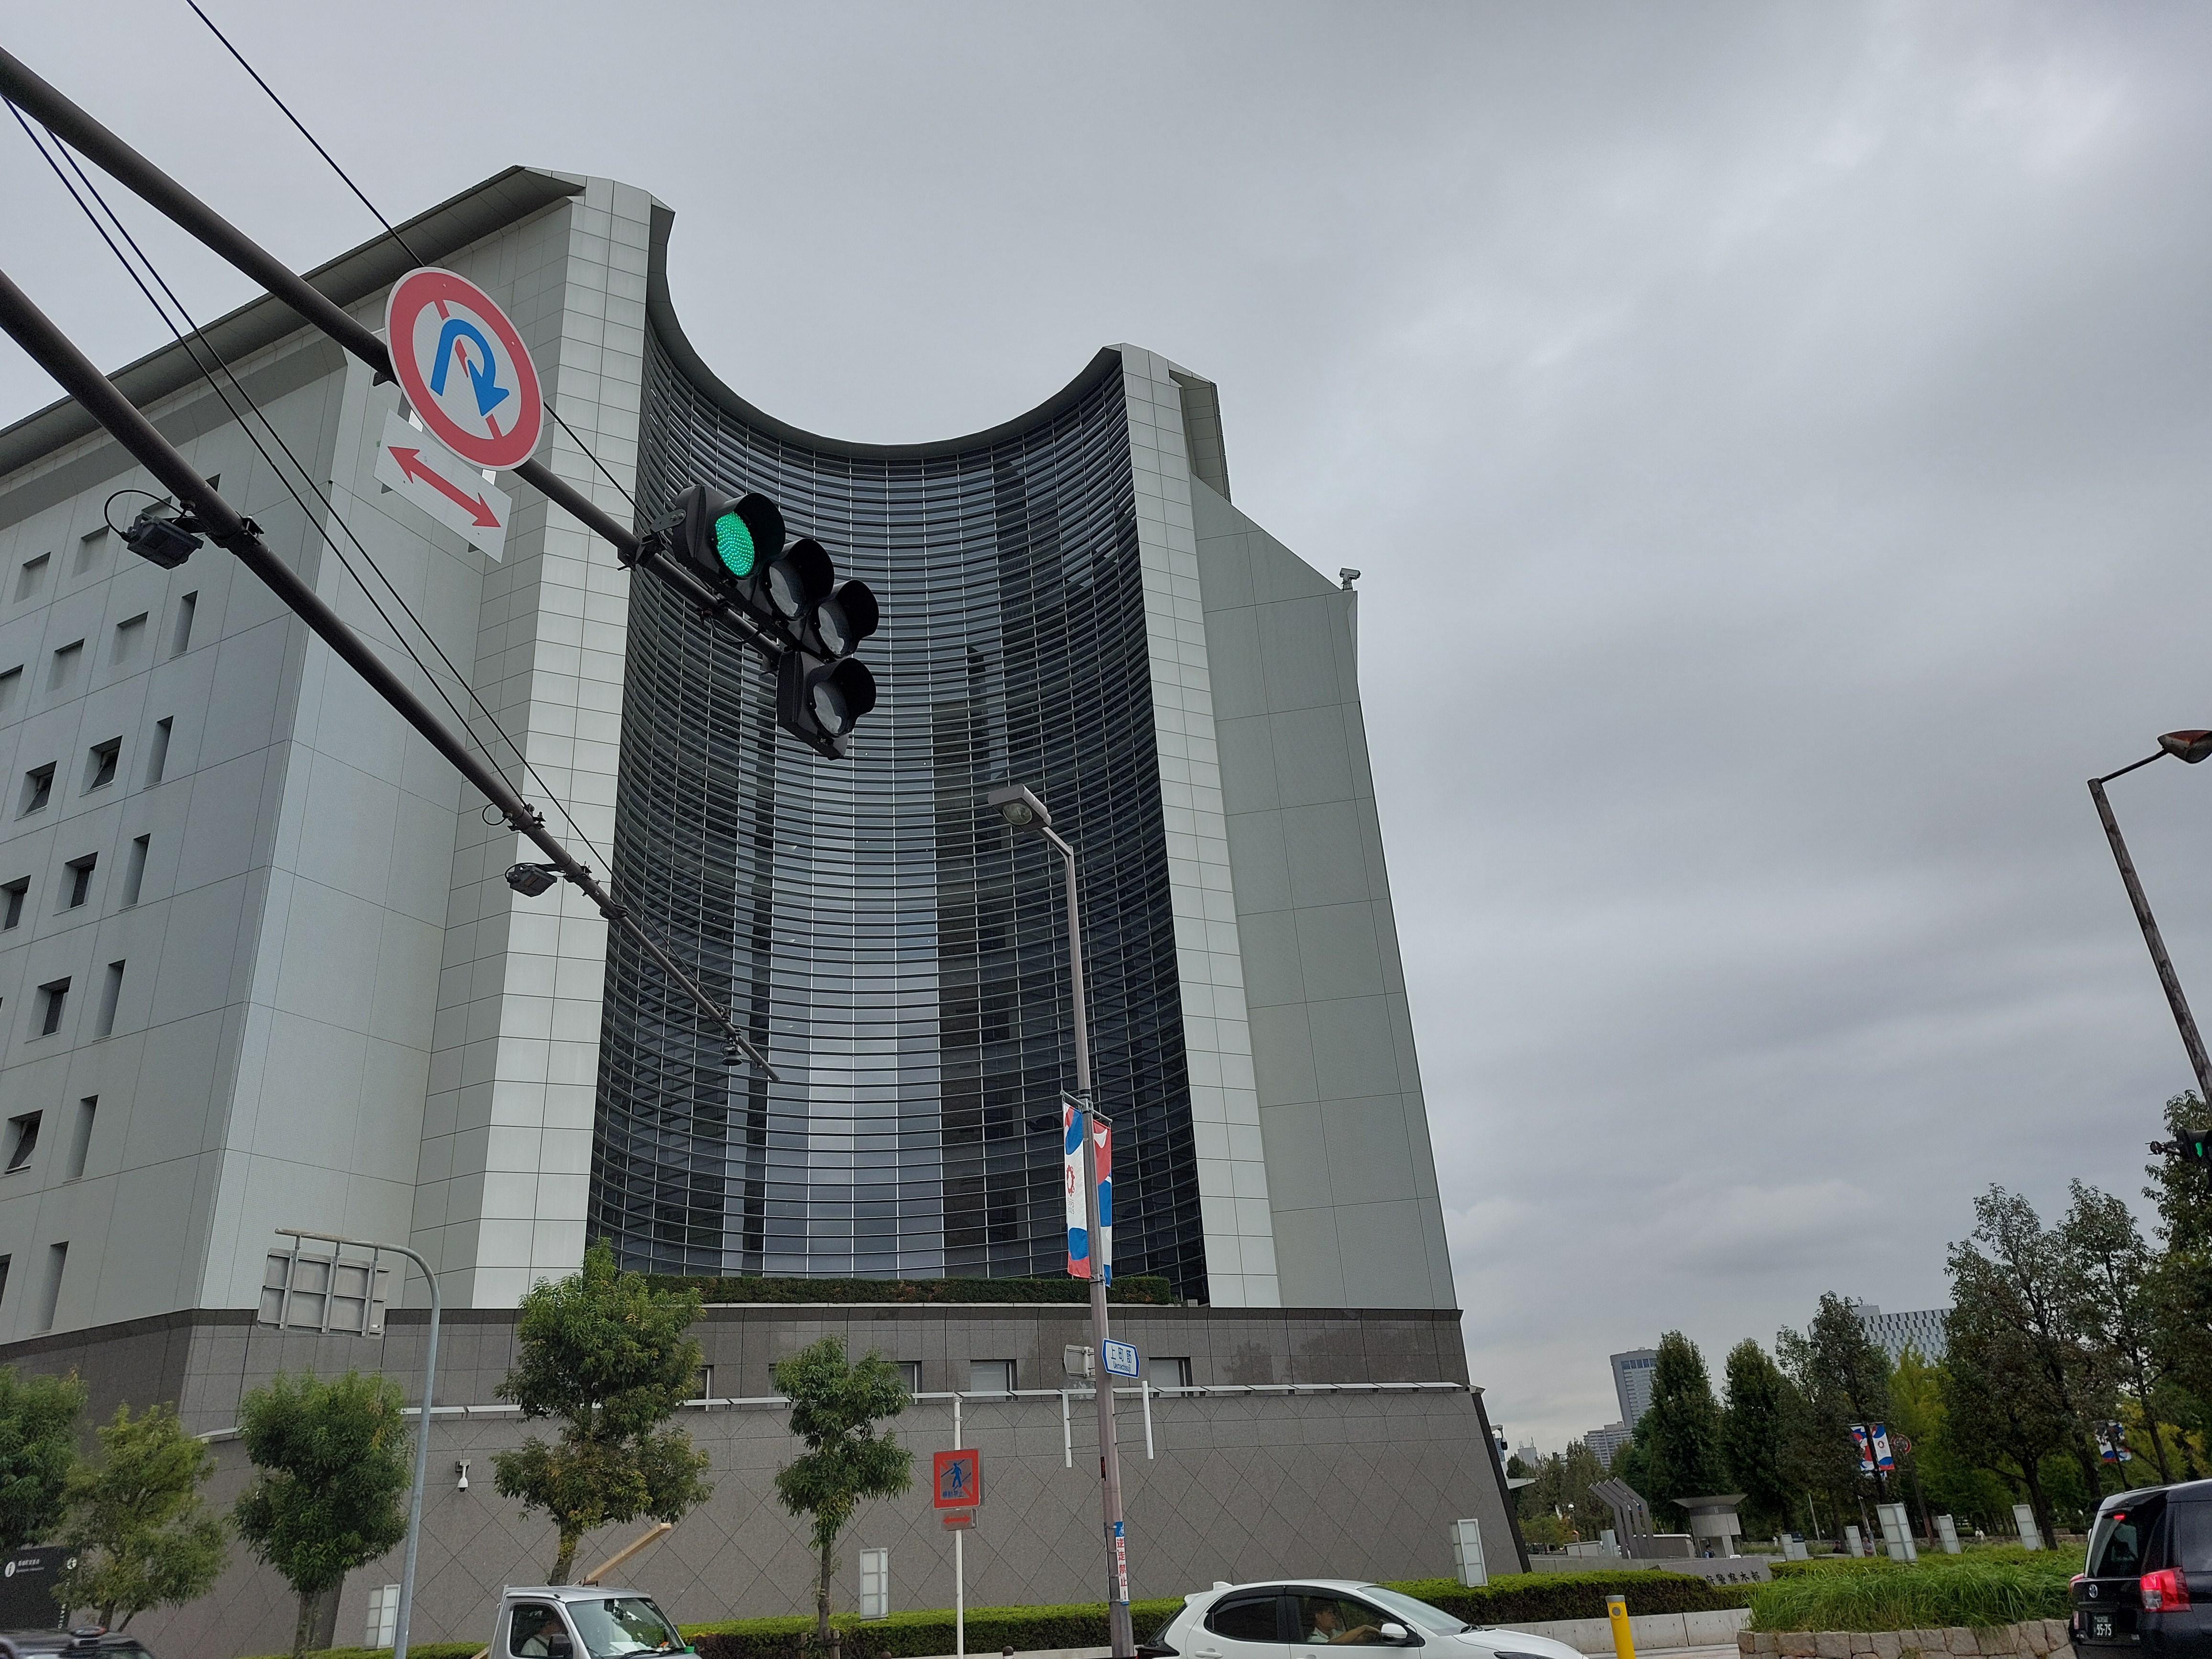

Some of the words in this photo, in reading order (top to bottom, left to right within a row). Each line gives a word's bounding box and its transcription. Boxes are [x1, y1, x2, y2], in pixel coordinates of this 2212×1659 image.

[1111, 1345, 1132, 1364] 上町筋
[1117, 1538, 1128, 1600] 逆走禁止!
